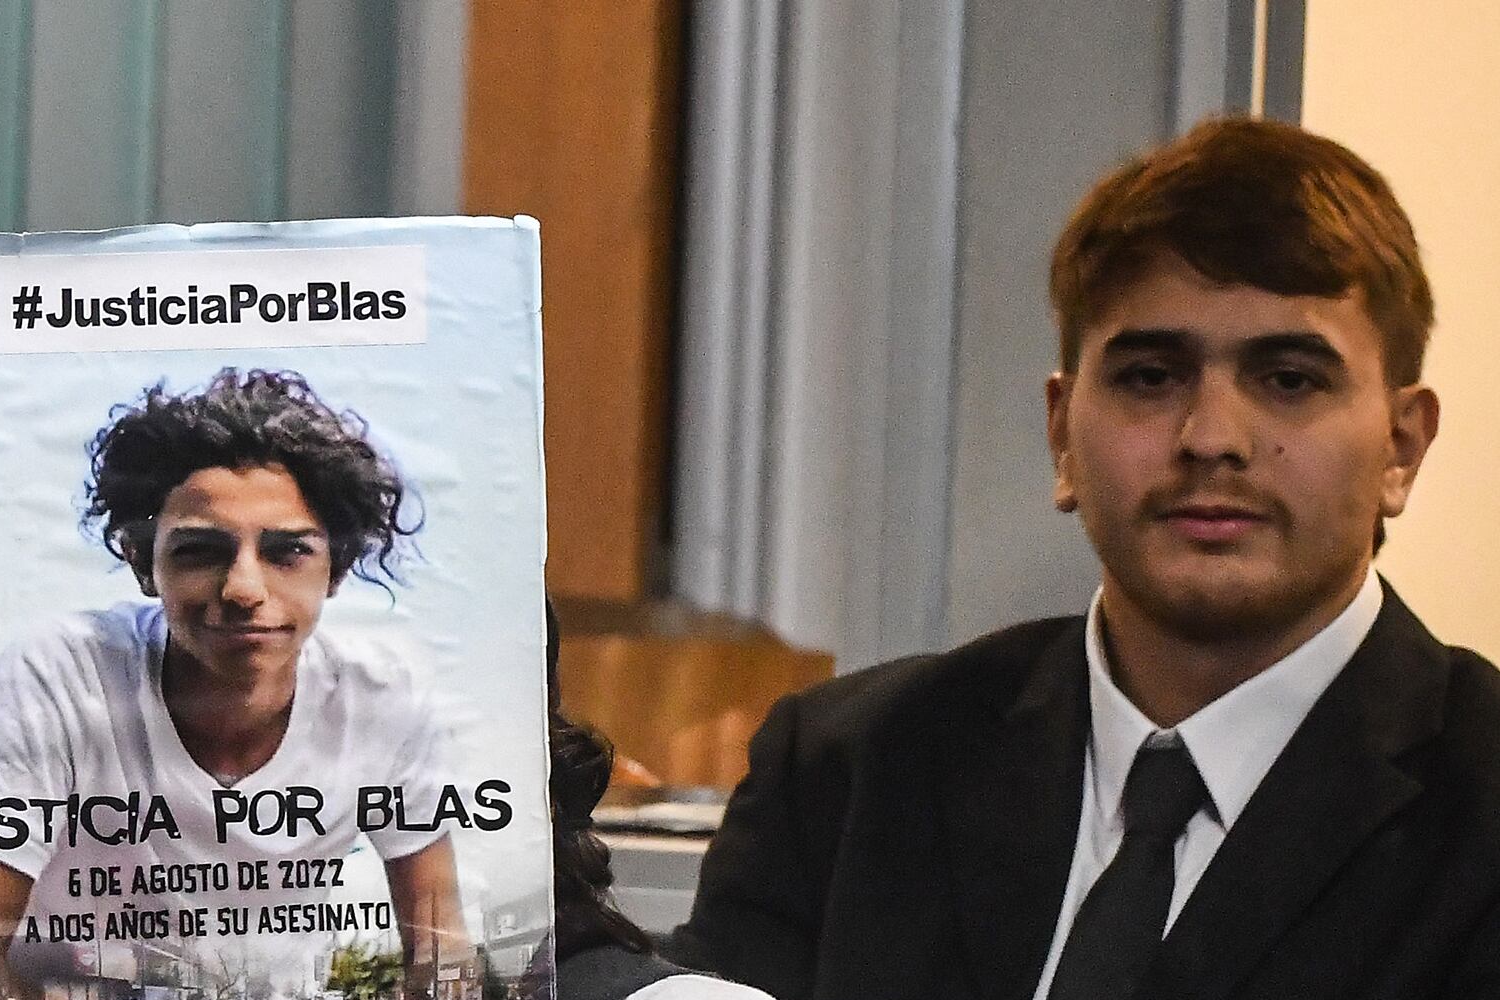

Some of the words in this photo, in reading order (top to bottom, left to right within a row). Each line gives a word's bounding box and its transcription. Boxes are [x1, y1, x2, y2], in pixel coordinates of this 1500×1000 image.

[13, 282, 406, 329] #JusticiaPorBlas
[213, 786, 326, 843] POR
[357, 780, 513, 832] BLAS
[68, 867, 82, 898] 6
[89, 866, 122, 897] DE
[131, 863, 228, 896] AGOSTO
[238, 861, 270, 891] DE
[278, 859, 344, 889] 2022
[25, 914, 42, 945] A
[49, 913, 95, 943] DOS
[105, 903, 171, 940] AÑOS
[179, 908, 208, 938] DE
[218, 907, 248, 936] SU
[258, 902, 392, 934] ASESINATO
